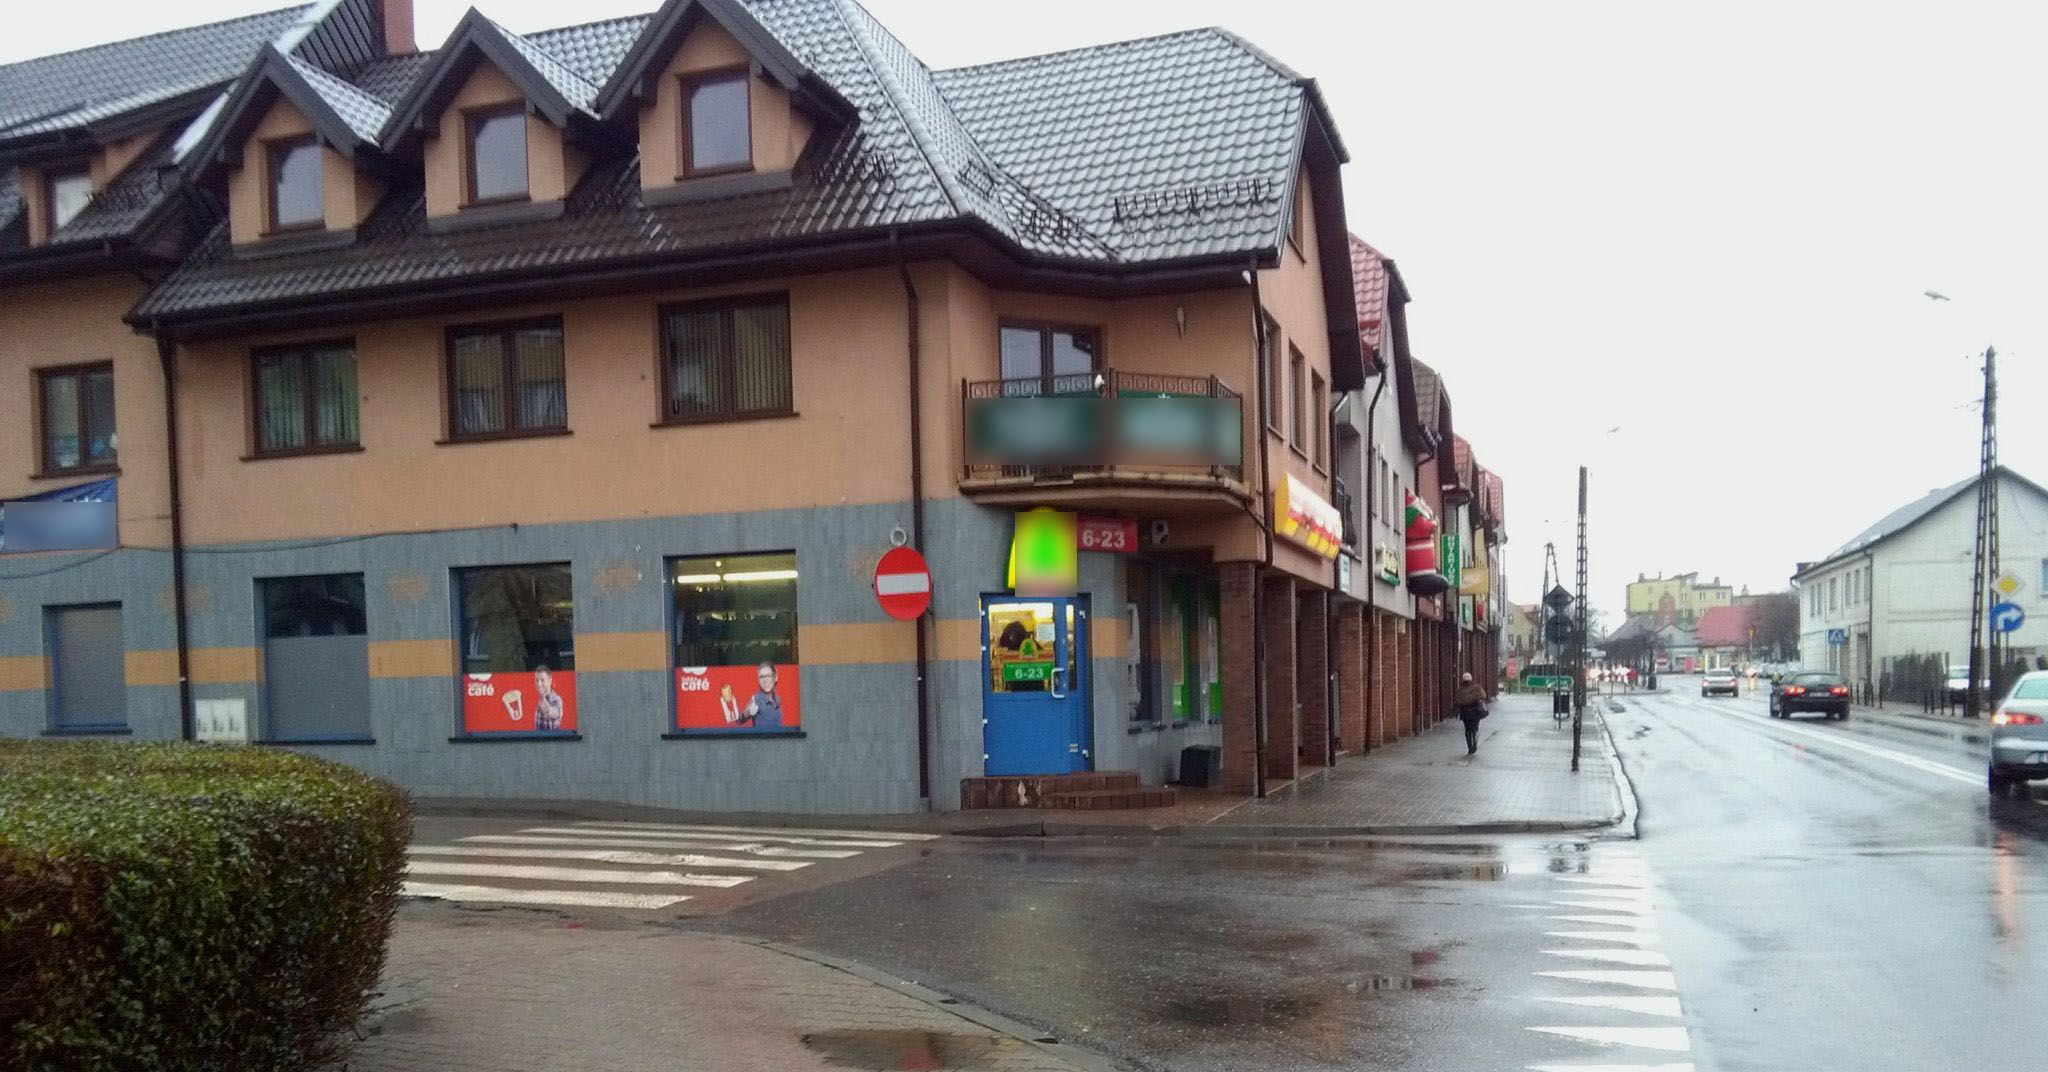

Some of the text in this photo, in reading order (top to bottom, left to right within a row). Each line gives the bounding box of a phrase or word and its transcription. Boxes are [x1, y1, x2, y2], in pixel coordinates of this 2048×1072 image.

[1082, 530, 1125, 548] 6-23
[1015, 668, 1044, 679] 6-23
[468, 683, 494, 697] café
[681, 677, 709, 691] café
